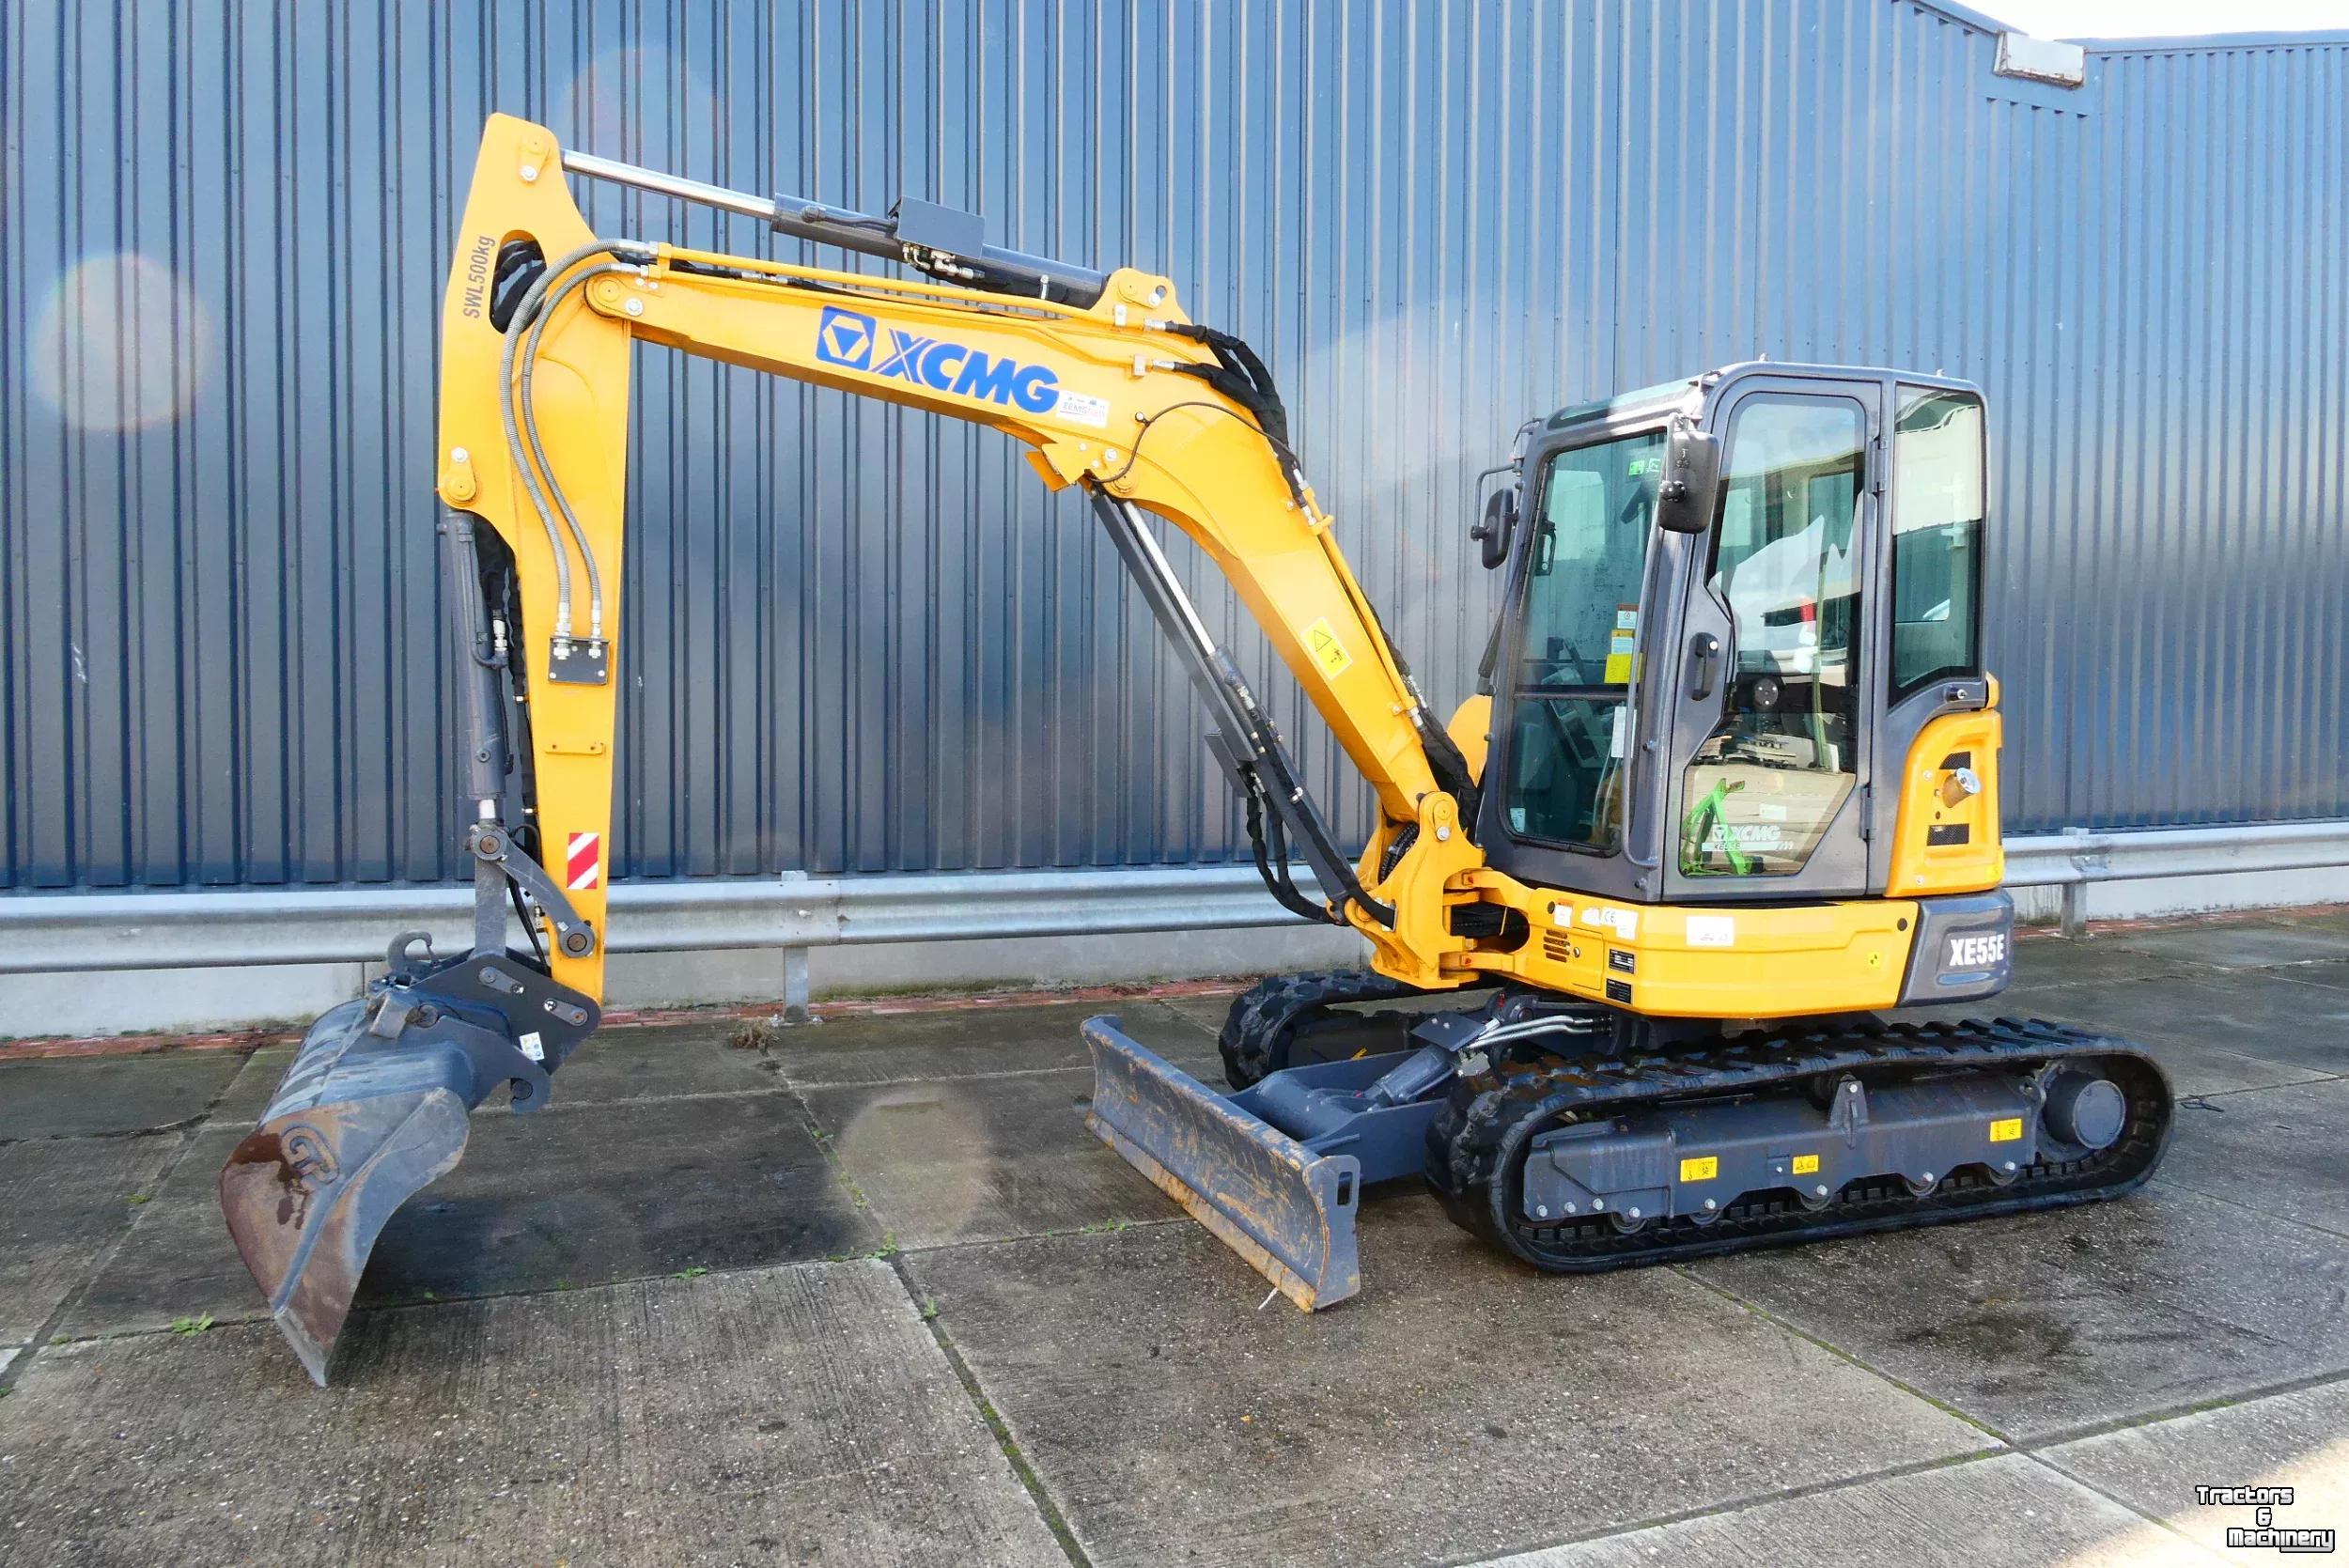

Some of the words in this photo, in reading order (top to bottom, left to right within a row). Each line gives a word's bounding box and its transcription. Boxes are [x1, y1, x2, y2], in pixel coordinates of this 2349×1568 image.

[463, 236, 496, 318] SWL500kg
[868, 328, 1060, 413] XCMG
[1949, 934, 2004, 966] XE55E
